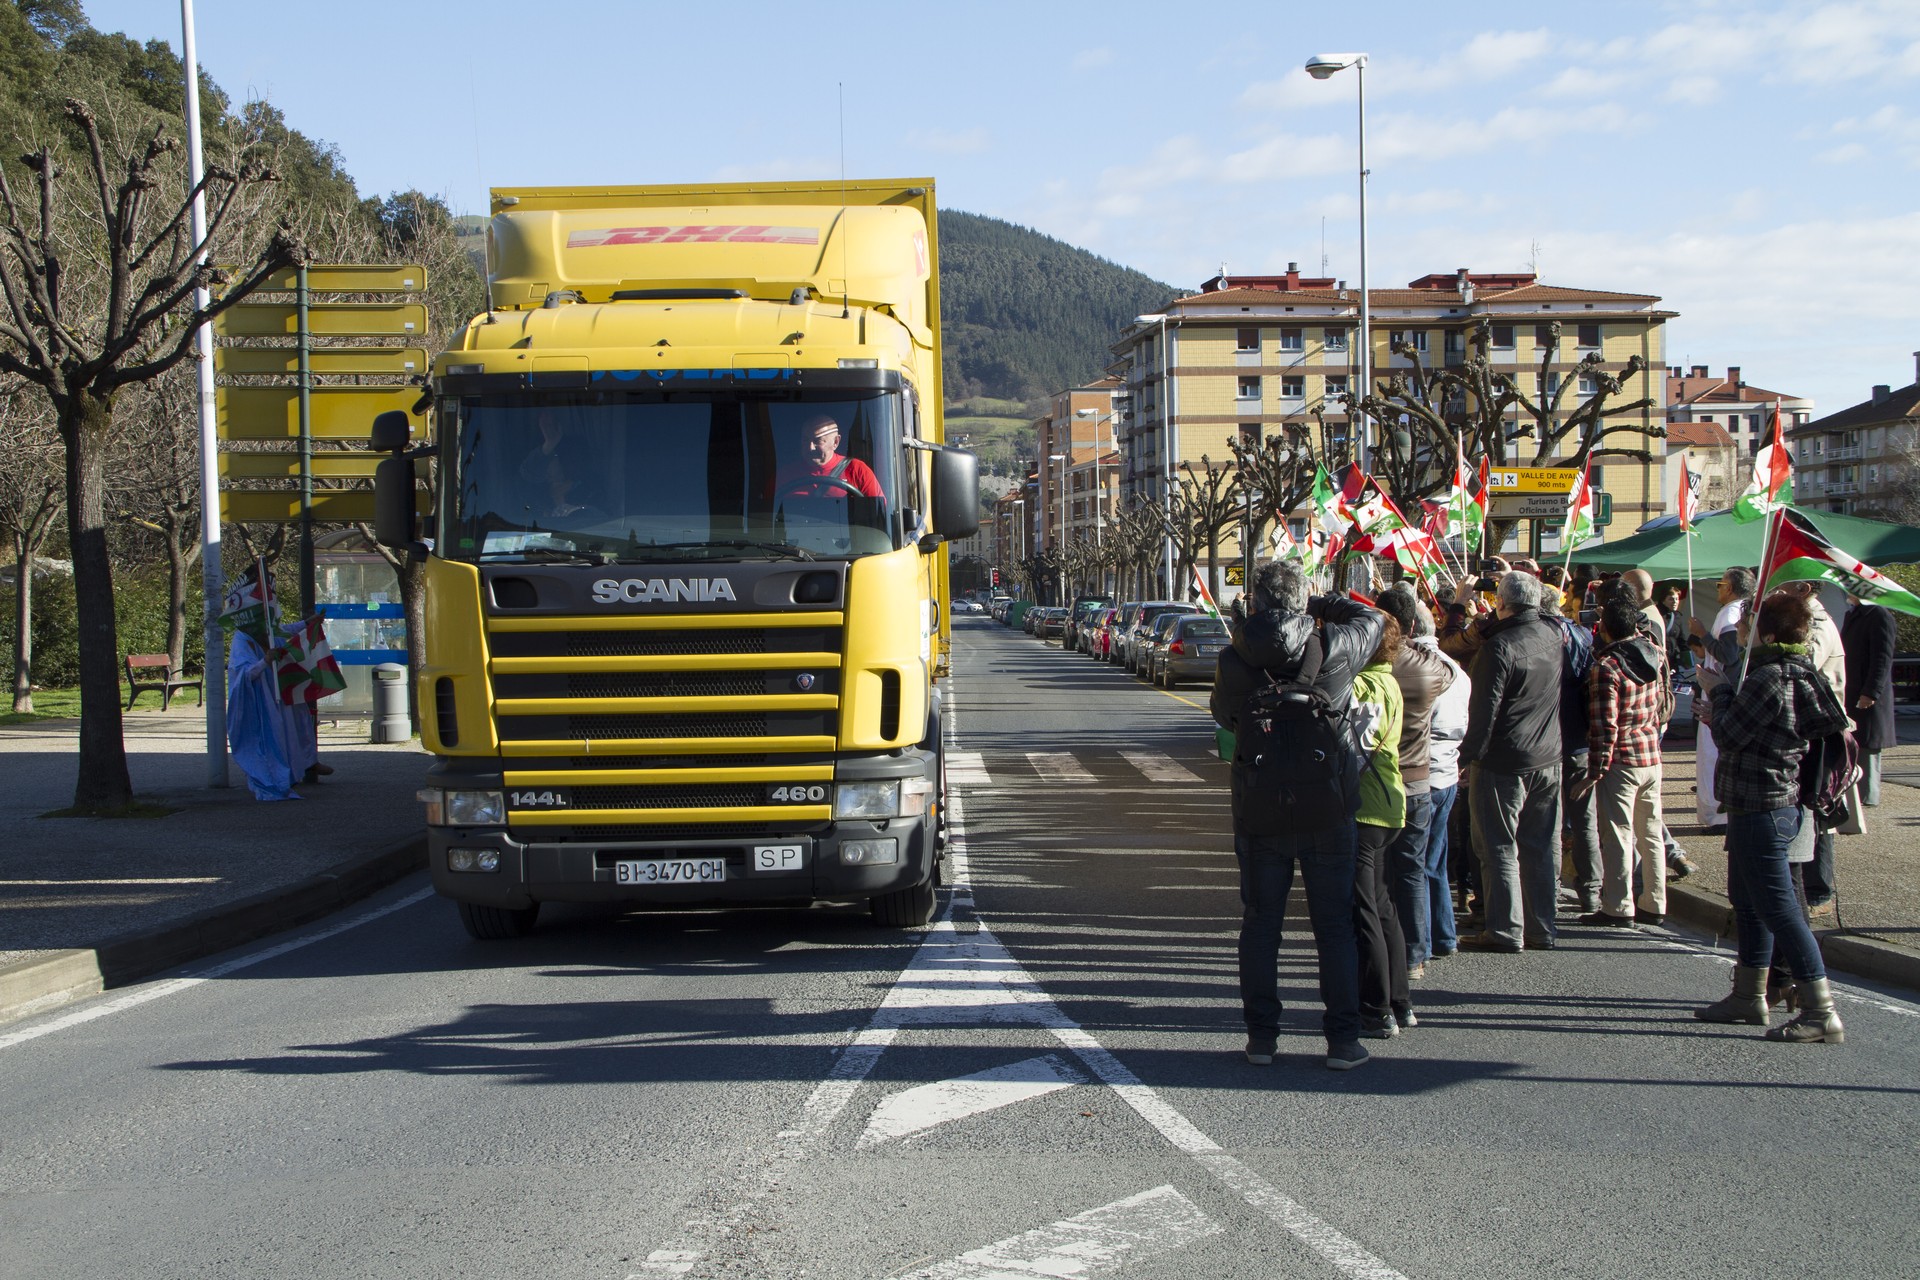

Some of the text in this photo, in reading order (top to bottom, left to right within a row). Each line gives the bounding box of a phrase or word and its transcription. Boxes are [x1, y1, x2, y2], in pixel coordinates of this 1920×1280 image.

[601, 225, 784, 246] DHL
[592, 578, 736, 604] SCANIA
[1820, 568, 1888, 600] LIBRE
[511, 791, 567, 806] 144L
[772, 786, 825, 802] 460
